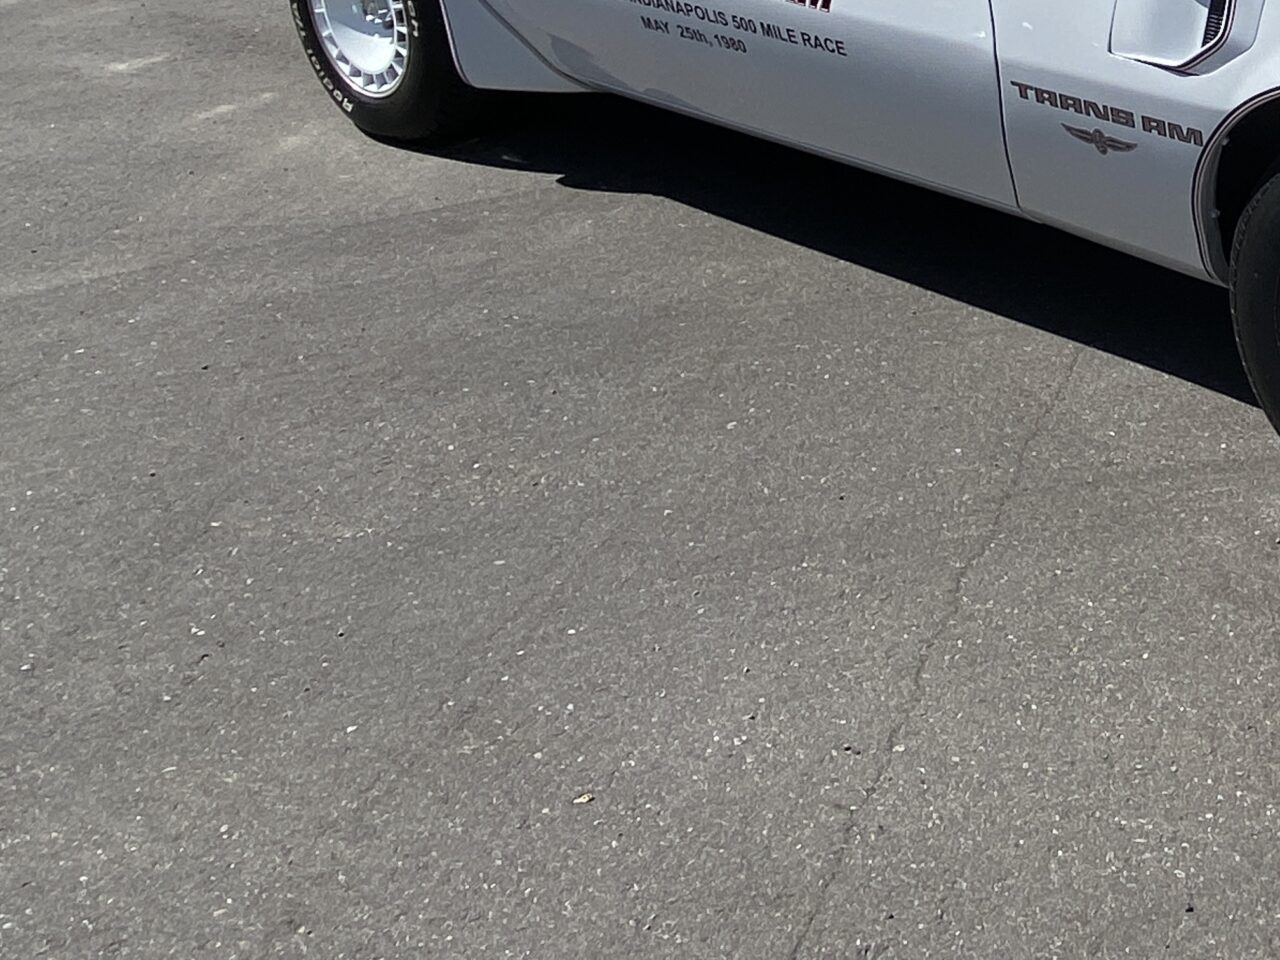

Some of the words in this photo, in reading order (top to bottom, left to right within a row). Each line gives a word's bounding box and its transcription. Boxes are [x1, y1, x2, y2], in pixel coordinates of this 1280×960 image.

[640, 15, 671, 35] MAY
[676, 25, 712, 48] 25th,
[714, 34, 748, 54] 1980
[732, 15, 757, 34] 500
[760, 22, 798, 44] MILE
[800, 32, 848, 57] RACE
[1010, 80, 1136, 129] TRANS
[1141, 115, 1204, 147] AM
